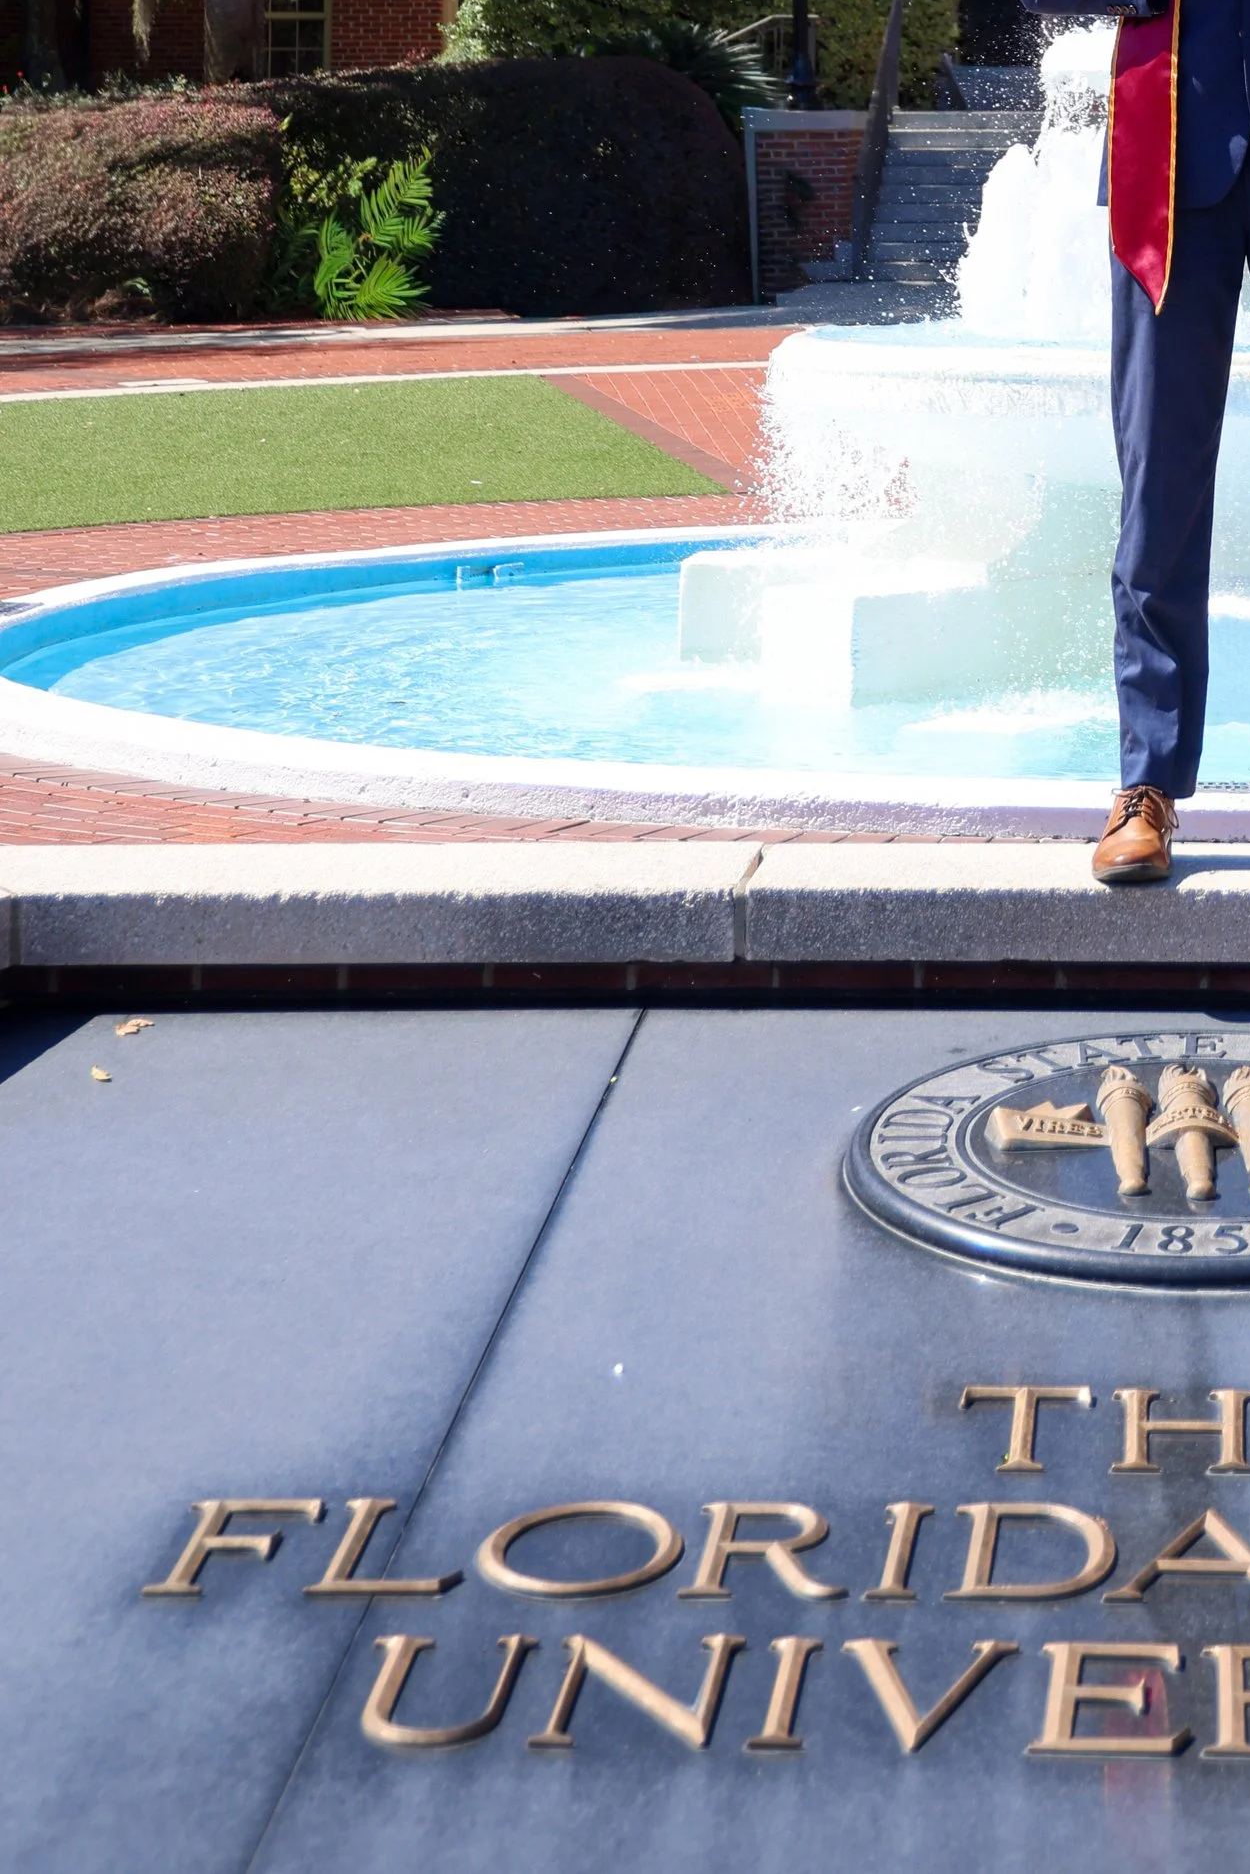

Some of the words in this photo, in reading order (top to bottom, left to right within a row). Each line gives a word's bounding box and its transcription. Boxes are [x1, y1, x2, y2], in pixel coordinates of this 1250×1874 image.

[877, 1094, 1045, 1230] FLORIDA
[976, 1034, 1227, 1084] STATE
[1015, 1114, 1104, 1138] VIRES
